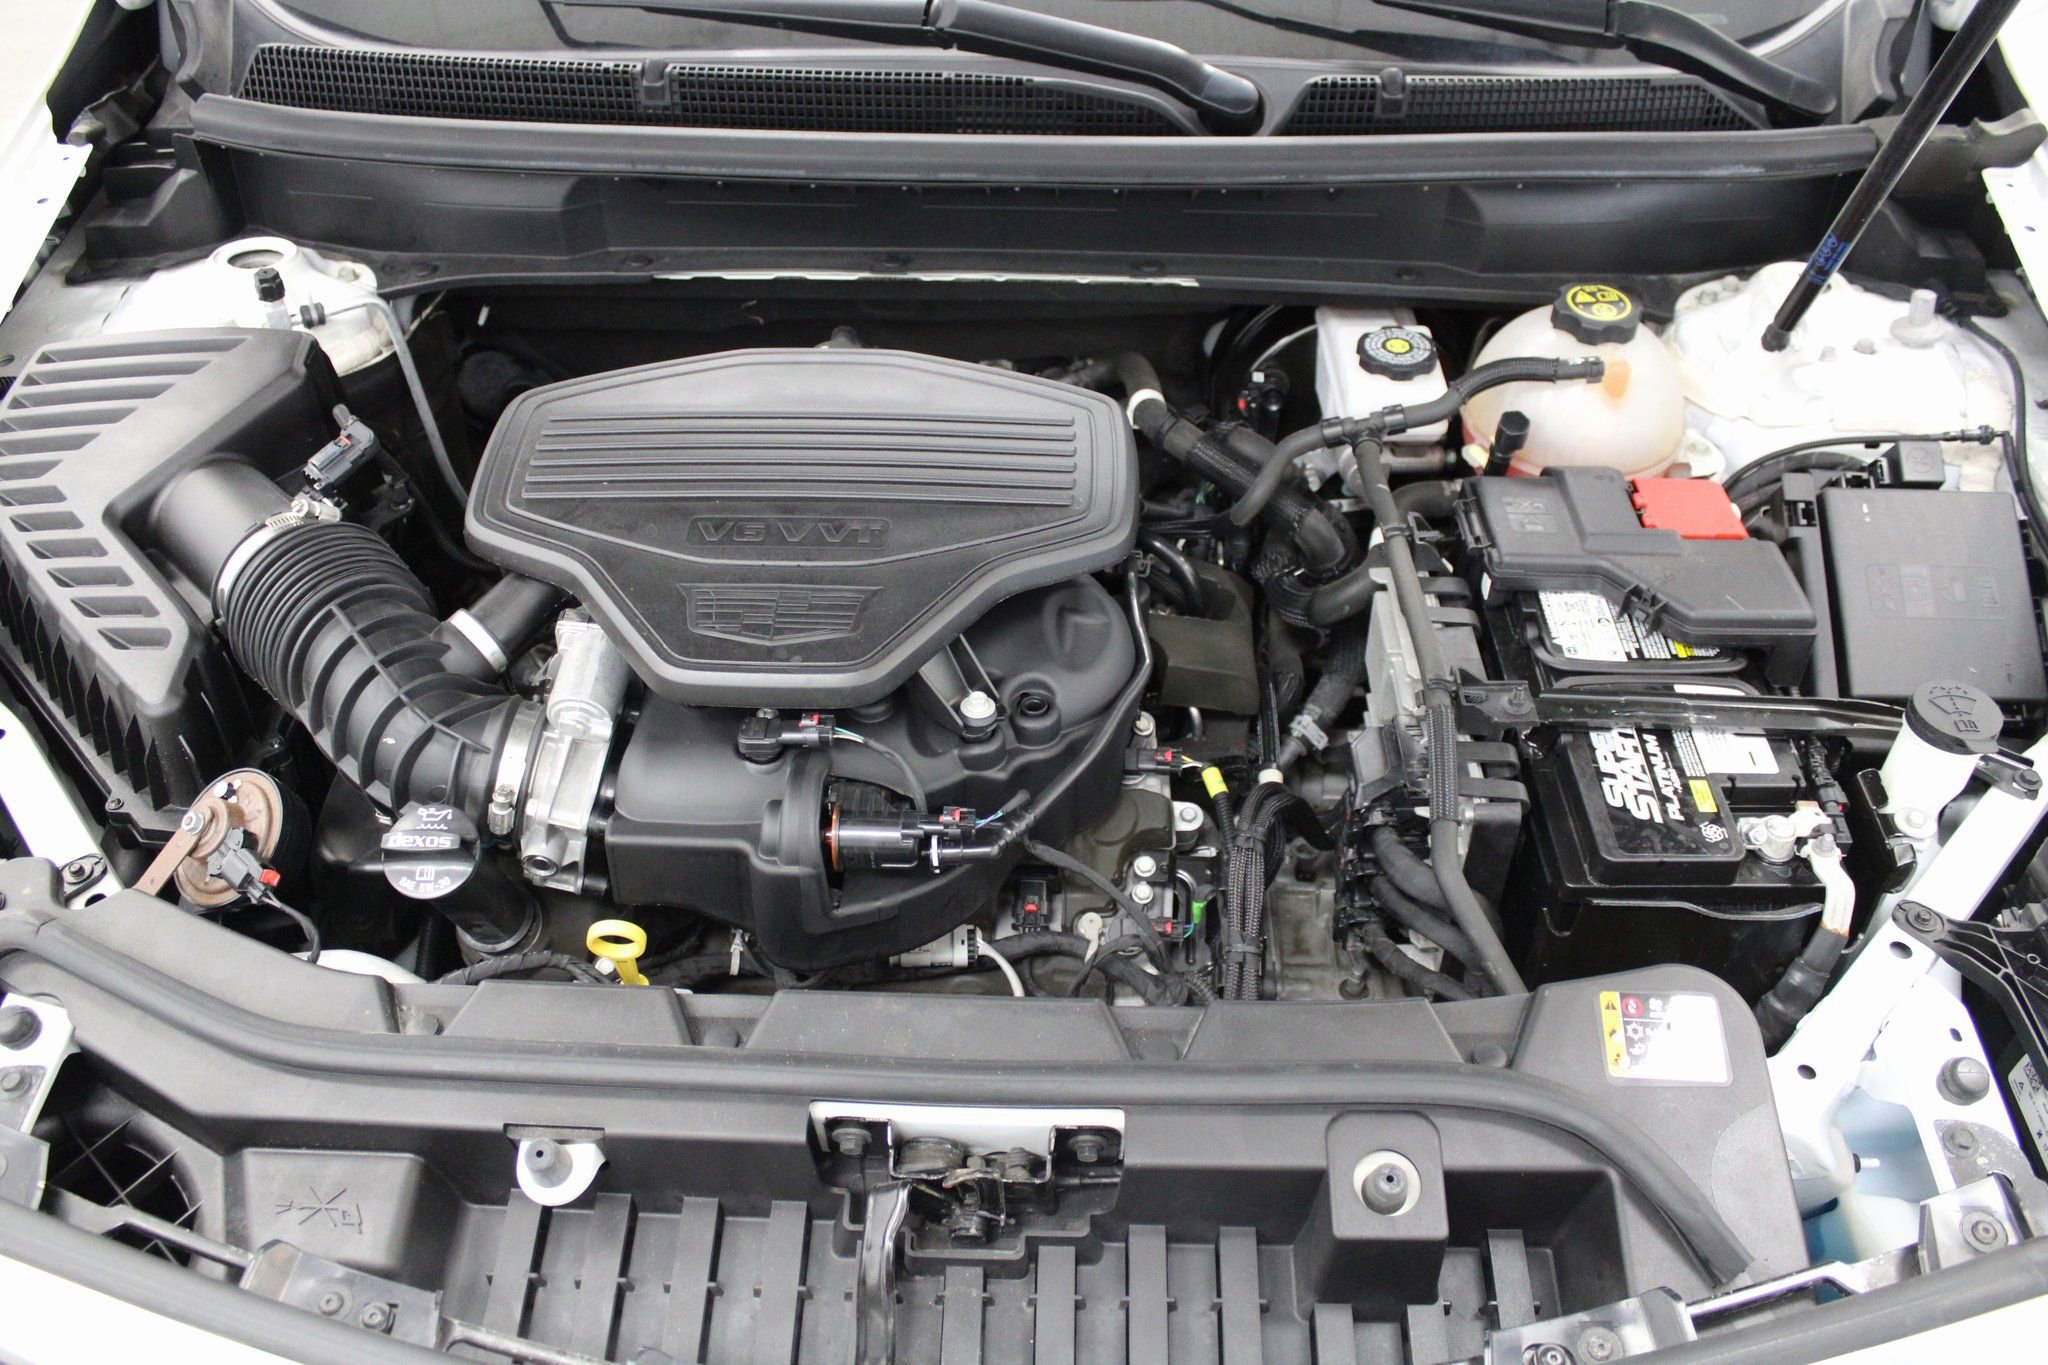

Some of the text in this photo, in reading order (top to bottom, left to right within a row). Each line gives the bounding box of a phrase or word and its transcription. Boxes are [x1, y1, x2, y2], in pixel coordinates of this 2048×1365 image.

[698, 521, 882, 543] V6 VVT
[1588, 731, 1624, 808] SUPE
[1642, 733, 1685, 821] PLATINUM
[387, 831, 454, 848] dexos
[399, 876, 451, 892] SAE 5W-30
